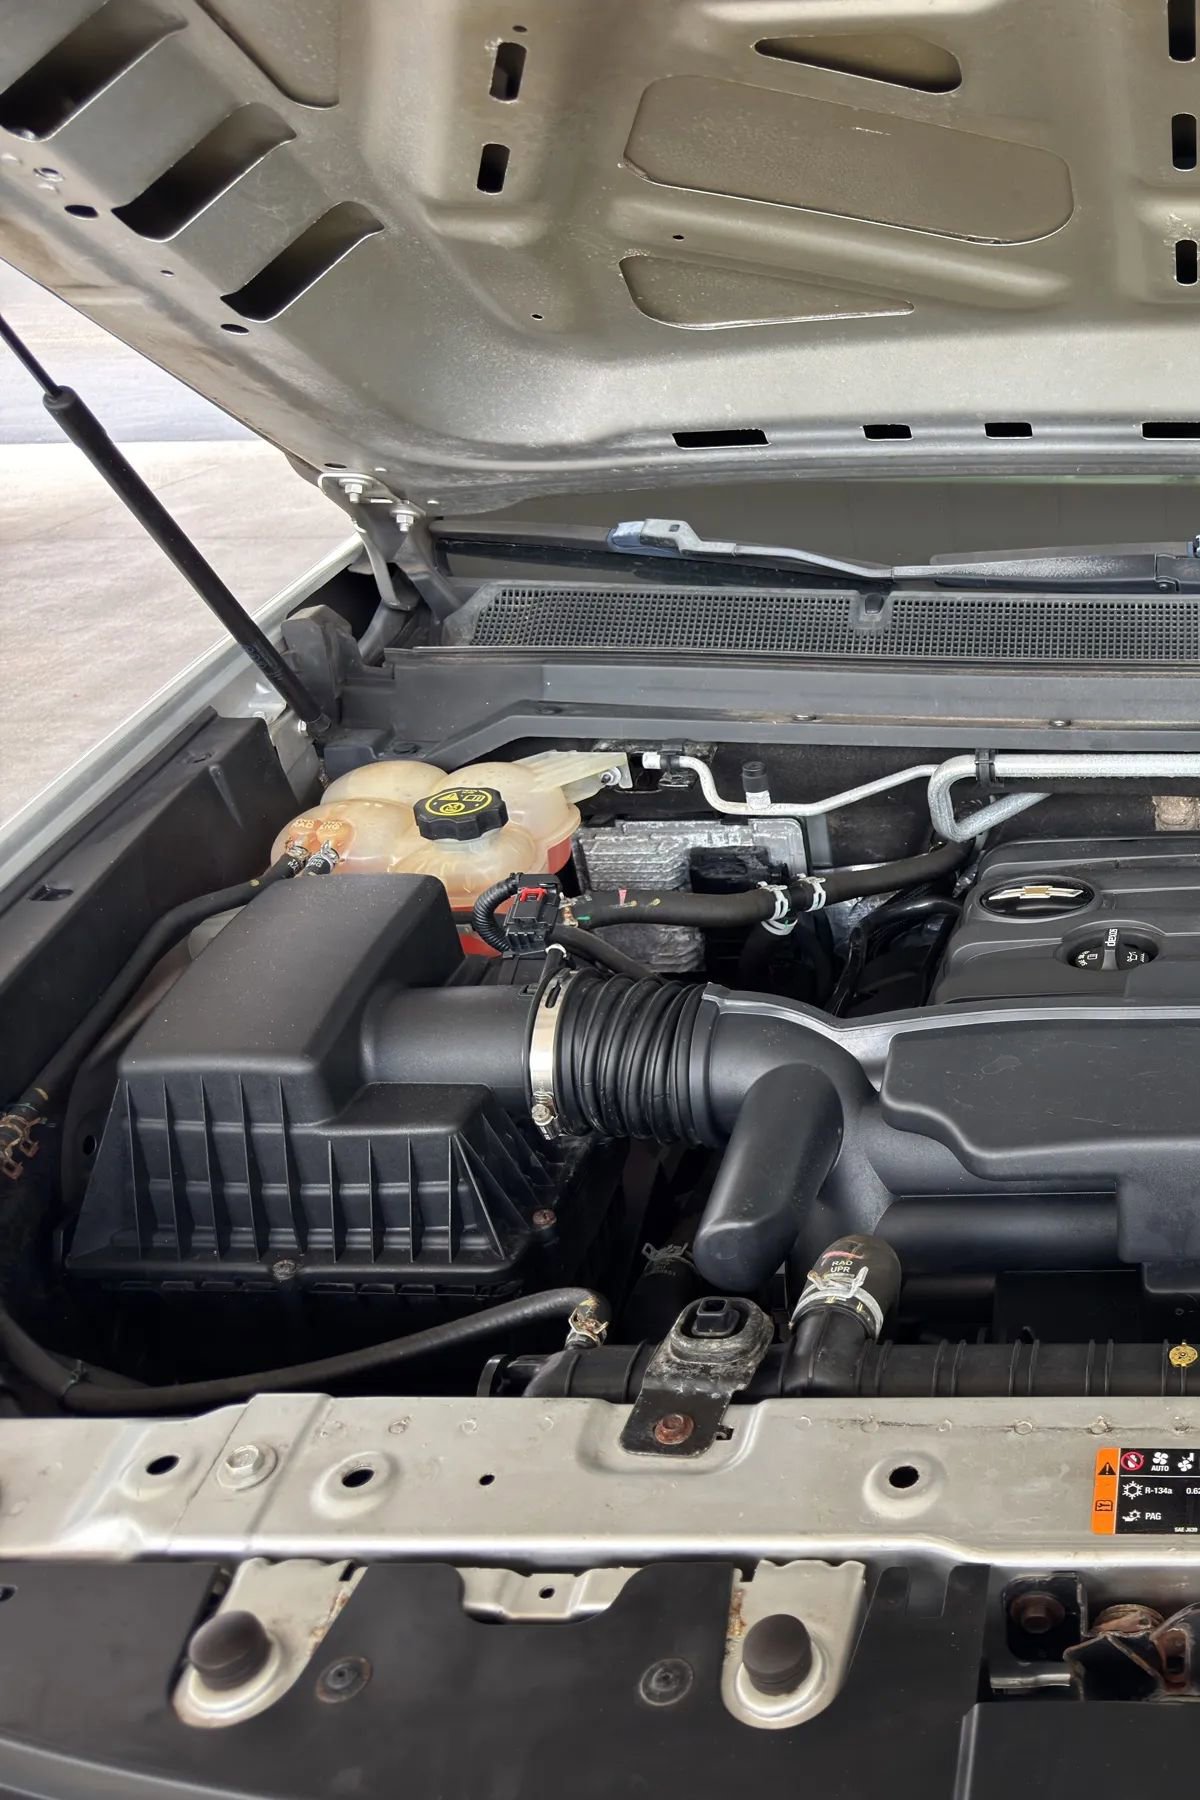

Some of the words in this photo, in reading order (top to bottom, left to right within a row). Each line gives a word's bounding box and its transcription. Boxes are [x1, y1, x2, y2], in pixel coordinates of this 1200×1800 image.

[1105, 929, 1118, 947] dexos
[1144, 1487, 1173, 1495] R-134a
[1144, 1512, 1162, 1521] PAG
